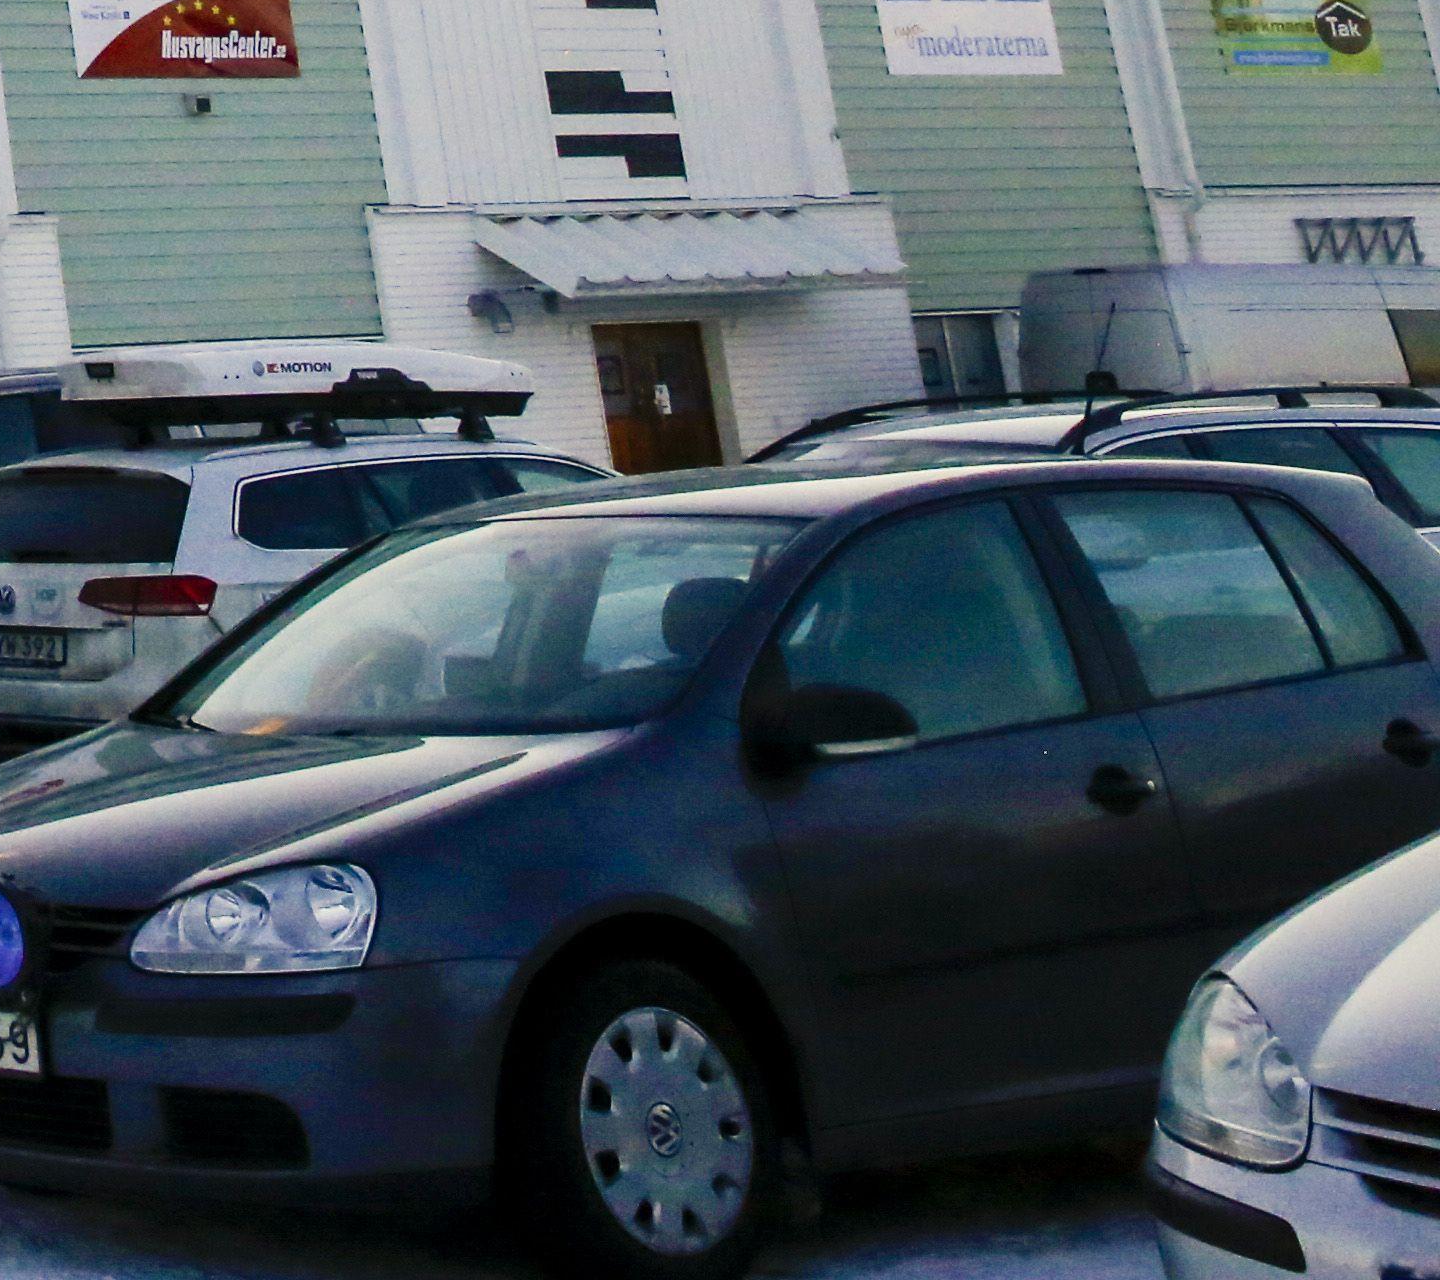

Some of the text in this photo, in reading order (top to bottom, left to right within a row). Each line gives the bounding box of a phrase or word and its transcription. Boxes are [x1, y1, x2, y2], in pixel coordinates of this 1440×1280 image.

[1325, 16, 1362, 37] Tak
[916, 27, 1049, 57] moderaterna
[281, 362, 332, 373] MOTION
